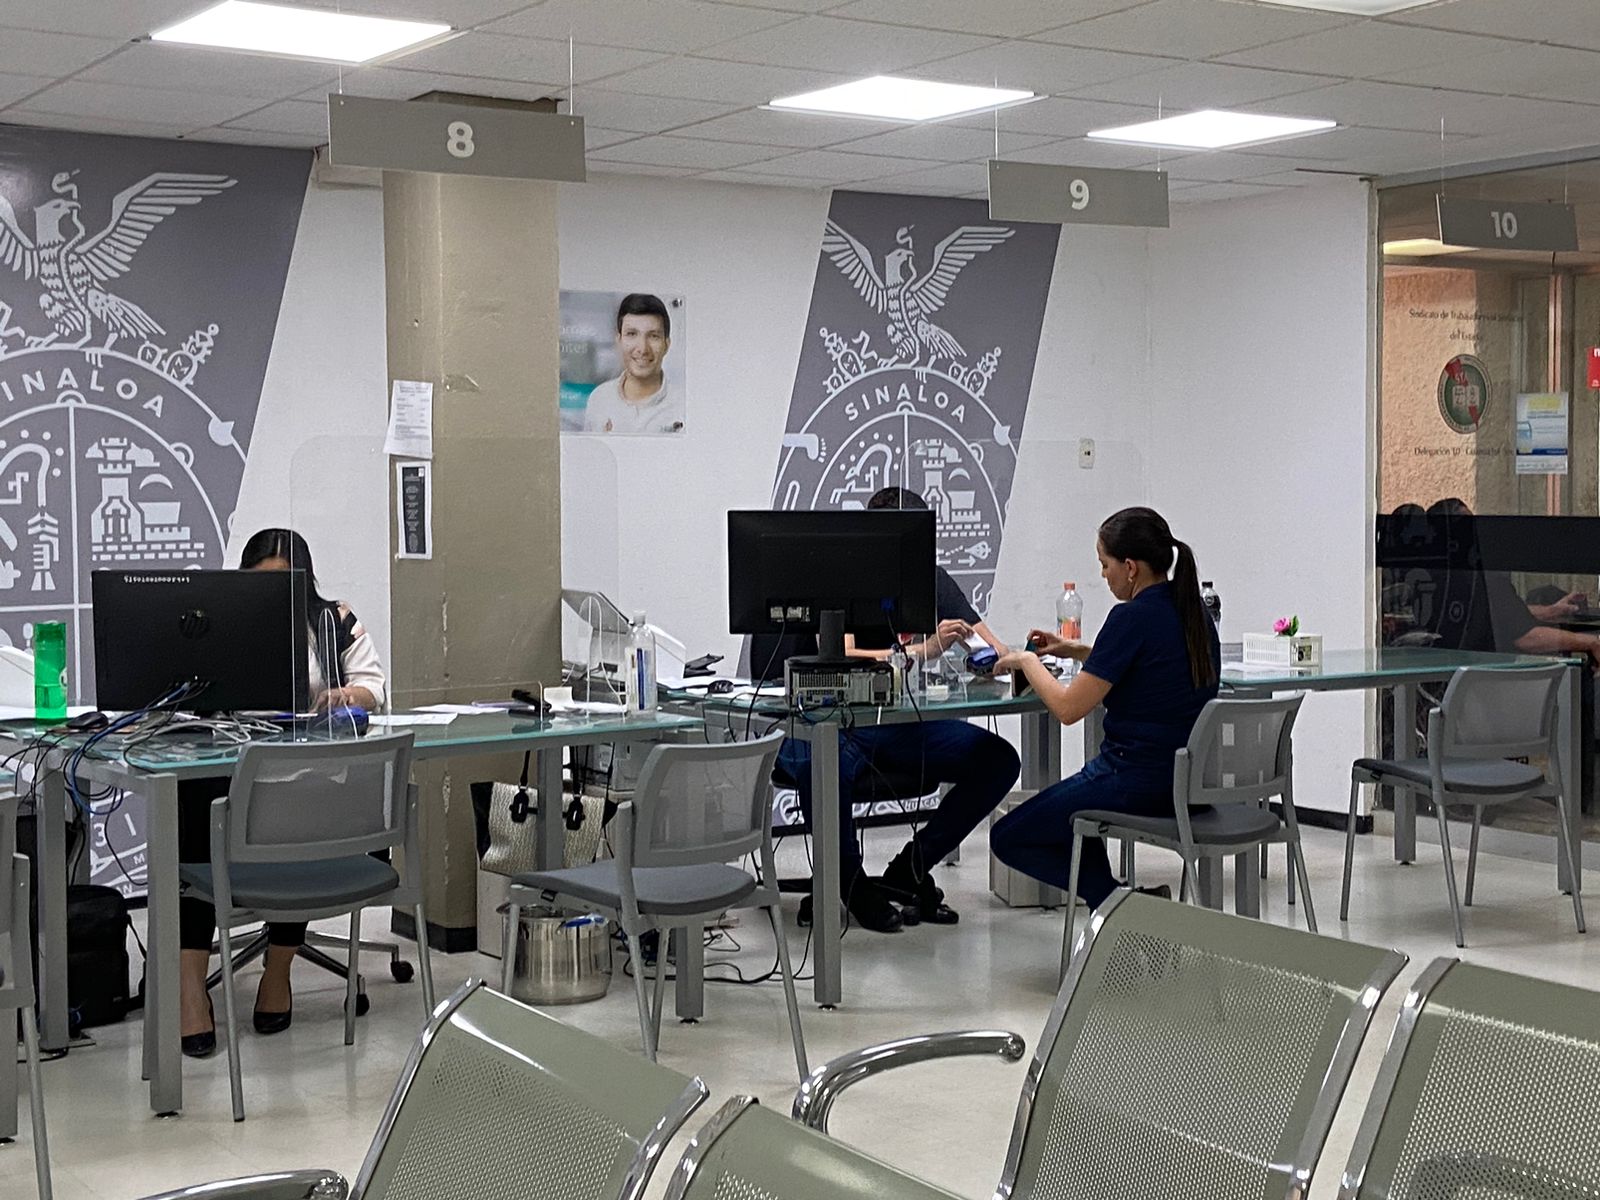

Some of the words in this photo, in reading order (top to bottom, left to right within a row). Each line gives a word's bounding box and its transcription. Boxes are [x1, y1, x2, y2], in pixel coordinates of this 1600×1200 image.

[447, 121, 475, 158] 8
[1070, 179, 1090, 210] 9
[1490, 211, 1518, 239] 10
[0, 368, 164, 418] INALOA
[845, 383, 965, 424] SINALOA
